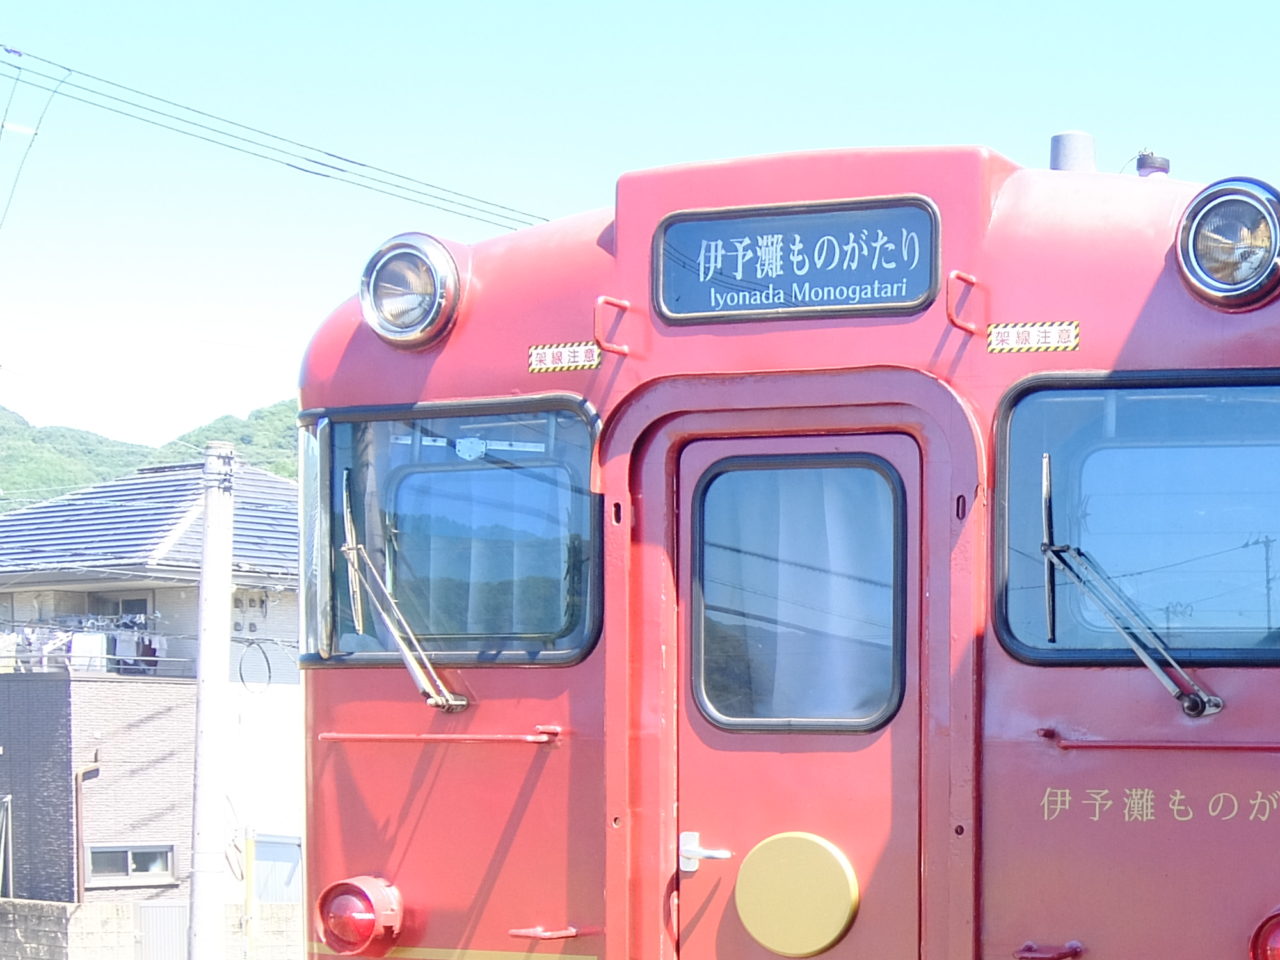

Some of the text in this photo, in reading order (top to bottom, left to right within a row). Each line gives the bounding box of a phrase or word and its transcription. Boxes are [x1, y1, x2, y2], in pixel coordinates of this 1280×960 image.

[696, 228, 920, 282] 伊予灘ものがたり
[710, 278, 907, 310] Iyonada Monogatari
[994, 328, 1073, 346] 架線注意
[534, 348, 595, 367] 架線注意
